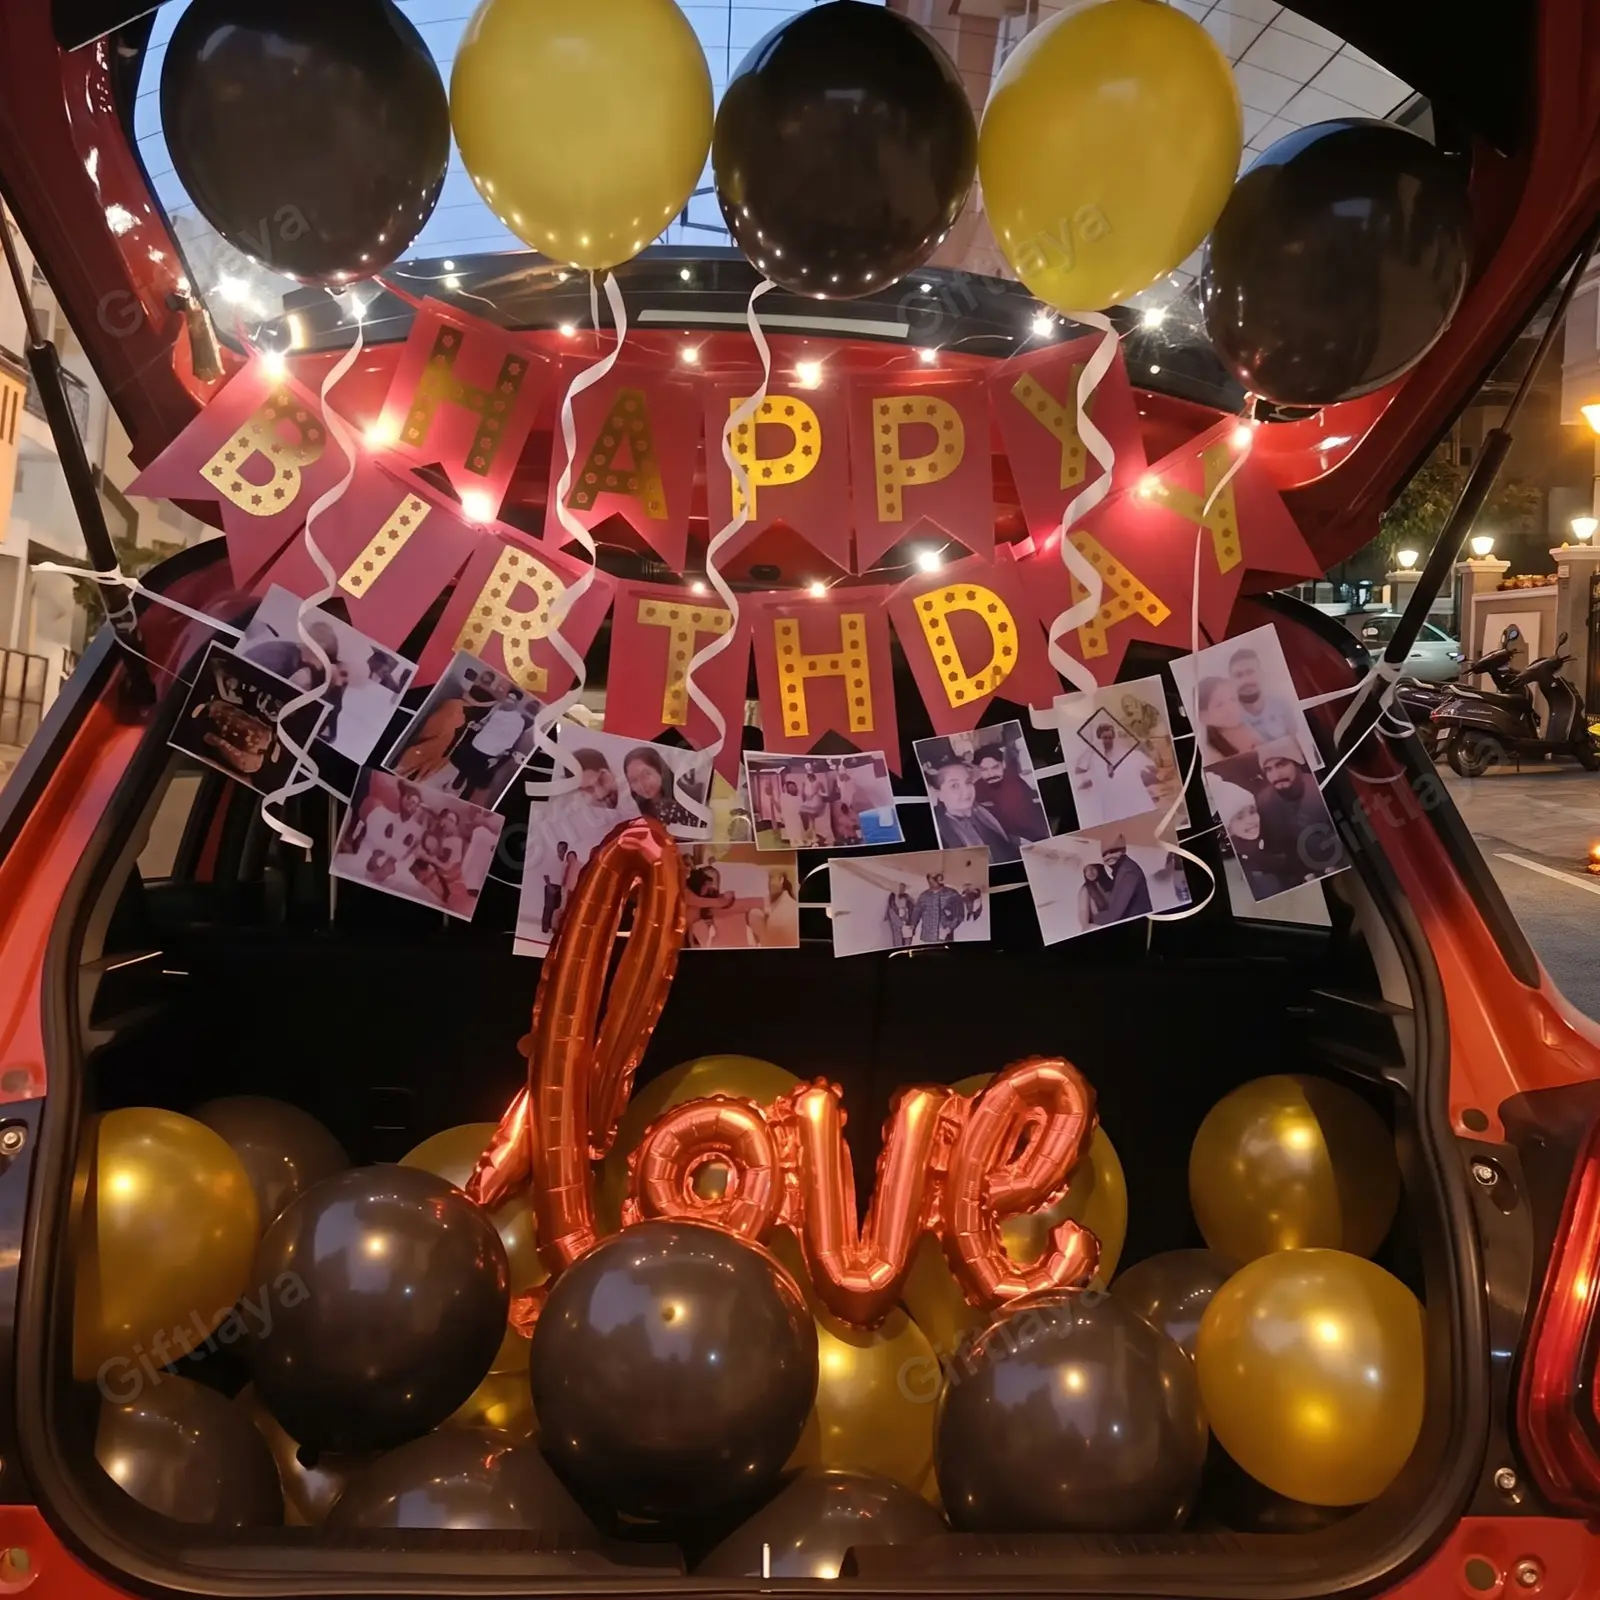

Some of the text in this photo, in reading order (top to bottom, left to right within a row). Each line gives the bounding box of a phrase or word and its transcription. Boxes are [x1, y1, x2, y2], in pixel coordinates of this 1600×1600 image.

[199, 385, 1243, 737] BIRTHDAY
[400, 324, 1096, 523] HAPPY
[465, 817, 1101, 1337] love
